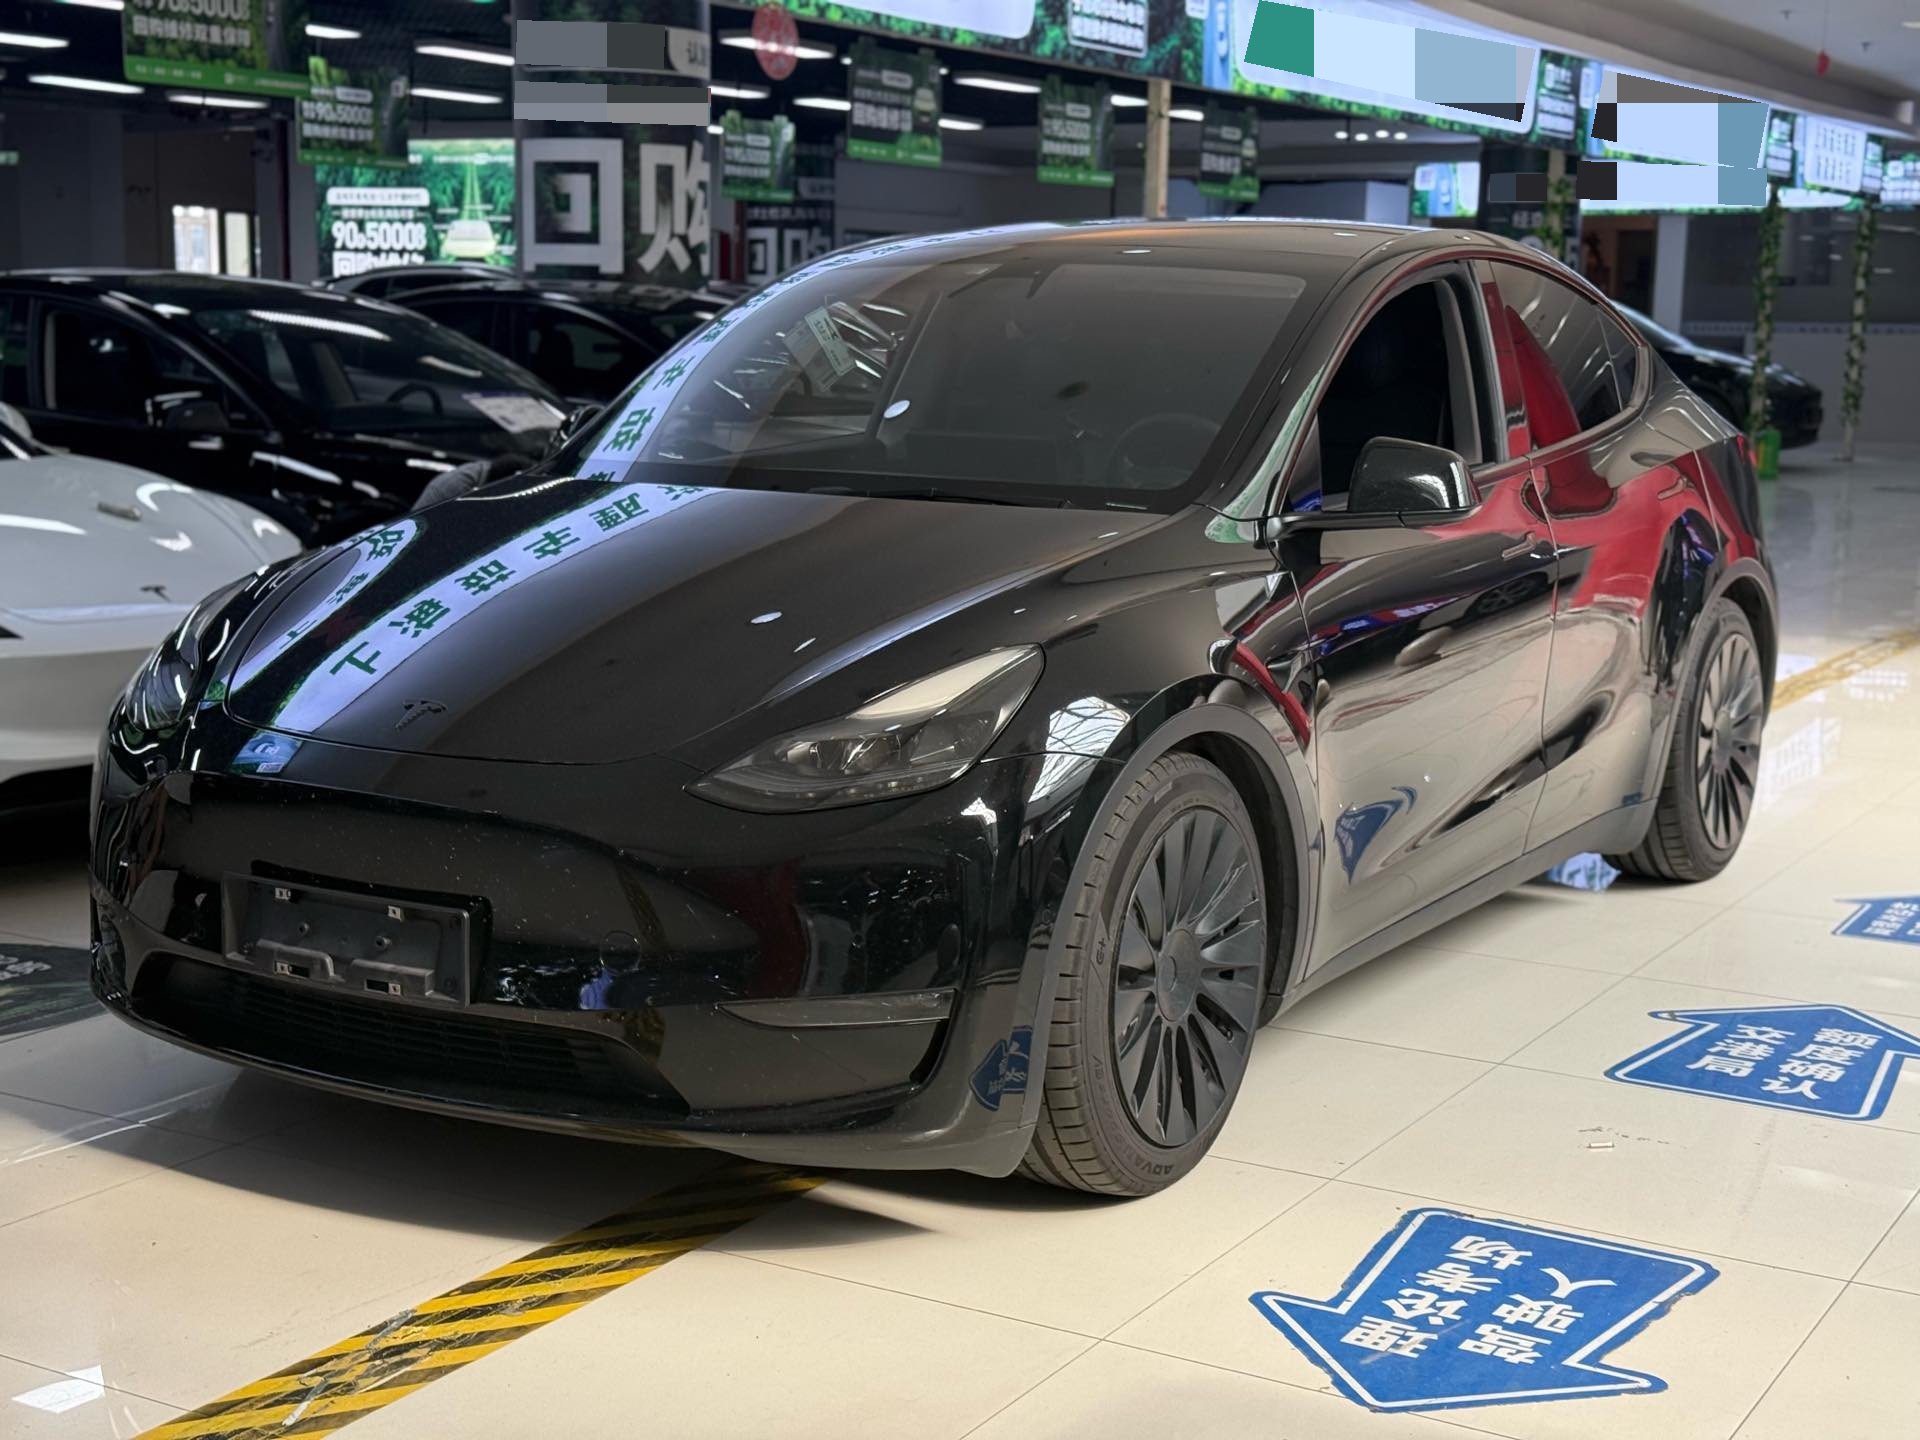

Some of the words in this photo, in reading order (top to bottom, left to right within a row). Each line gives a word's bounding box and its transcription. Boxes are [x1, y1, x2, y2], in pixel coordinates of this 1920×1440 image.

[1686, 1024, 1796, 1077] 交港局
[1760, 1028, 1883, 1100] 额度确认
[1340, 1235, 1534, 1359] 理论考场
[1458, 1266, 1618, 1365] 驾驶人
